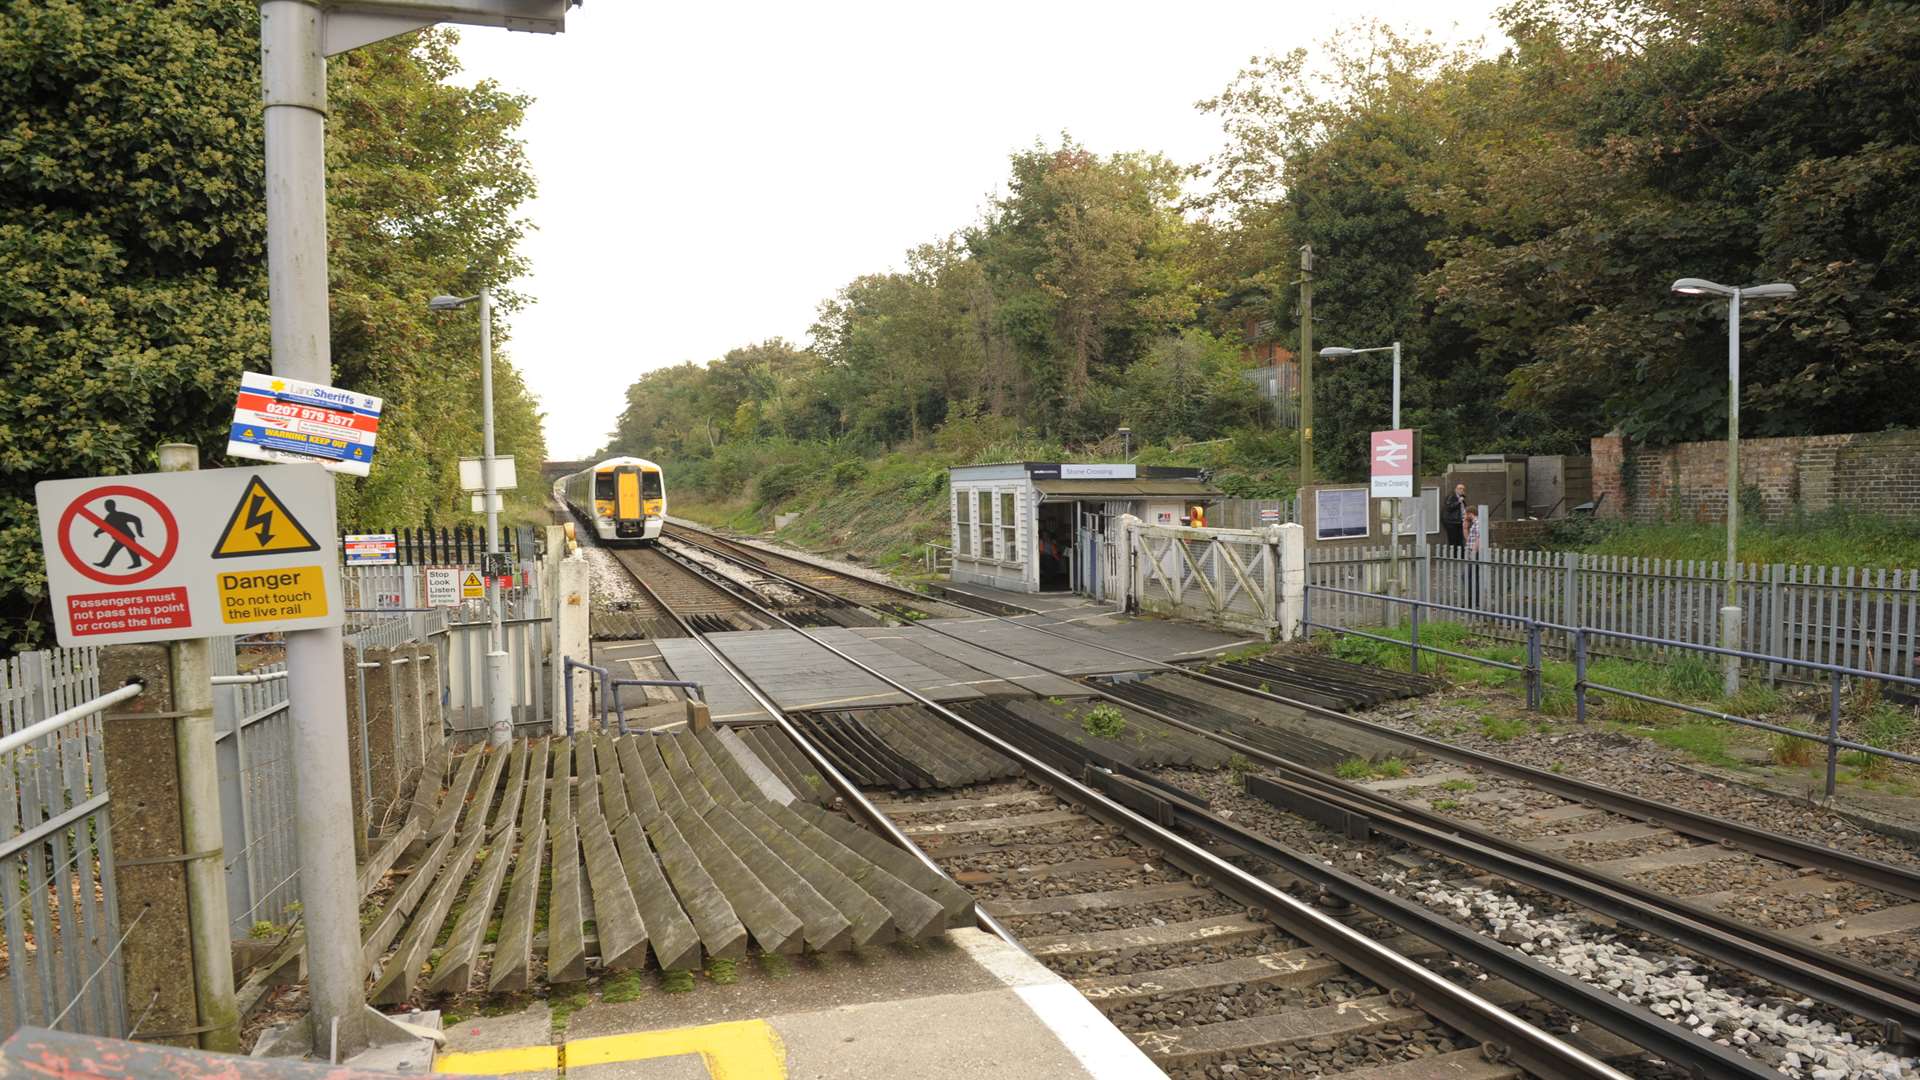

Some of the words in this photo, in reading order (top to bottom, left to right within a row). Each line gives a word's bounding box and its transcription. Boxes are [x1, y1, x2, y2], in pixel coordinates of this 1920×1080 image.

[291, 384, 354, 405] LandSheriffs
[266, 403, 298, 417] 0207
[301, 408, 325, 421] 979
[327, 413, 355, 427] 3577
[223, 573, 301, 590] Danger
[430, 571, 449, 579] Stop
[71, 595, 144, 609] Passengers
[145, 592, 177, 603] must
[226, 597, 245, 607] Do
[248, 594, 269, 605] not
[273, 592, 312, 603] touch
[73, 610, 94, 620] not
[96, 609, 127, 620] pass
[128, 606, 152, 616] this
[153, 603, 185, 615] point
[229, 609, 250, 619] the
[254, 607, 277, 617] live
[280, 604, 301, 615] rail
[75, 623, 89, 631] or
[91, 620, 126, 630] cross
[127, 618, 148, 627] the
[150, 616, 173, 625] line
